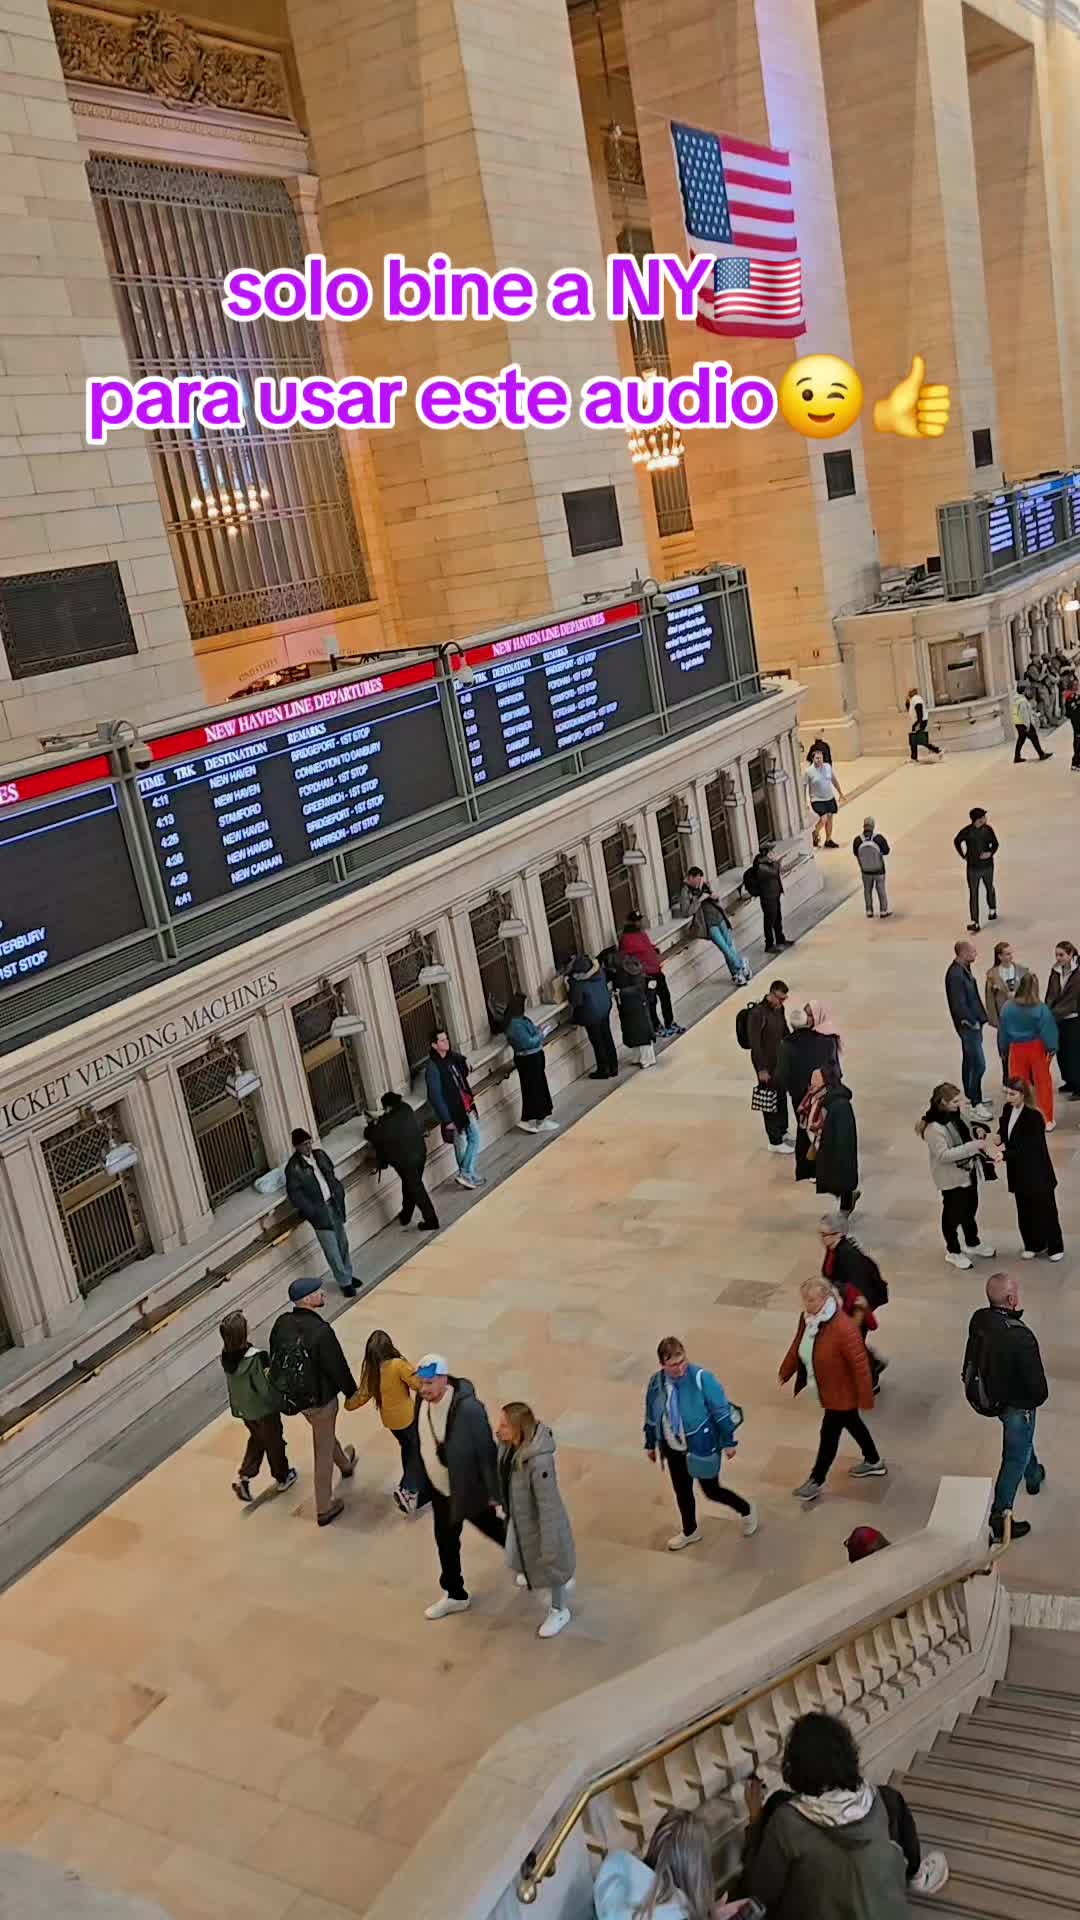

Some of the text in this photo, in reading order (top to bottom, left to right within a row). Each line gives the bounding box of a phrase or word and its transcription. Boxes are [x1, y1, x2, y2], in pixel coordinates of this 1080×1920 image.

[491, 612, 605, 657] NEW HAVEN LINE DEPARTURES
[204, 678, 384, 742] NEW HAVEN LINE DEPARTURES
[139, 723, 326, 792] TIME TRK DESTINATION REMARKS
[152, 741, 380, 808] 4:11 NEW HAVEN CONNECTION TO DANBURY
[209, 773, 229, 789] NEW
[230, 765, 256, 782] HAVEN
[291, 738, 336, 762] BRIDGEPORT
[340, 733, 352, 745] 1ST
[353, 727, 370, 742] STOP
[156, 813, 174, 828] 4:13
[218, 803, 261, 827] STAMFORD
[299, 777, 334, 797] FORDHAM
[338, 770, 350, 783] 1ST
[351, 764, 368, 779] STOP
[223, 830, 241, 846] NEW
[242, 819, 269, 839] HAVEN
[303, 792, 345, 815] GREENWICH
[348, 785, 360, 798] 1ST
[361, 778, 379, 793] STOP
[227, 849, 246, 864] NEW
[246, 838, 273, 857] HAVEN
[306, 807, 350, 833] BRIDGEPORT
[354, 801, 366, 814] 1ST
[367, 794, 384, 810] STOP
[231, 867, 250, 884] NEW
[250, 854, 283, 875] CANAAN
[310, 828, 346, 851] HARRISON
[350, 821, 362, 834] 1ST
[362, 814, 380, 830] STOP
[19, 950, 48, 971] STOP
[0, 972, 279, 1127] ICKET VENDING MACHINES
